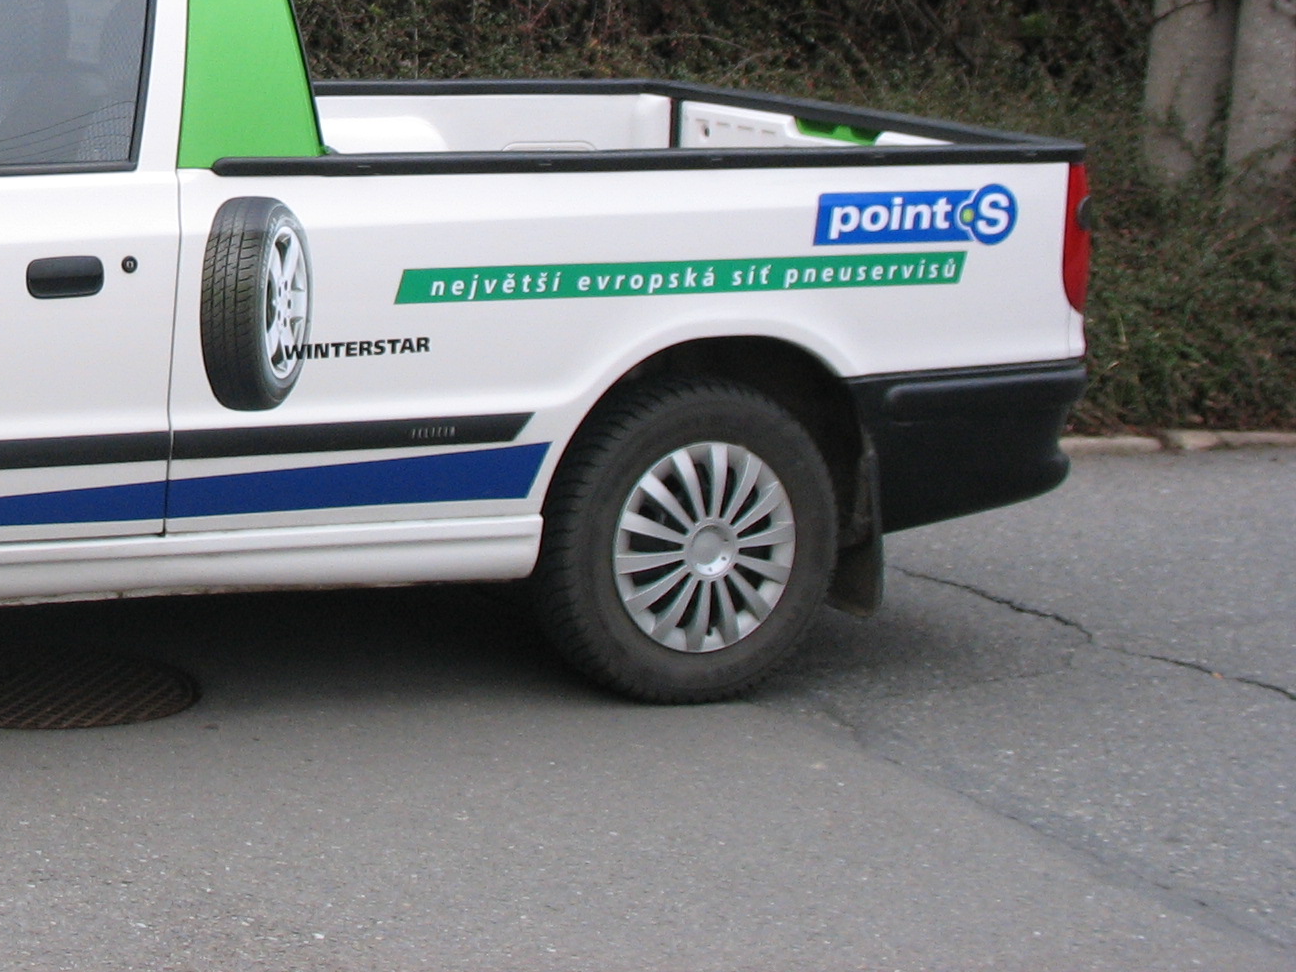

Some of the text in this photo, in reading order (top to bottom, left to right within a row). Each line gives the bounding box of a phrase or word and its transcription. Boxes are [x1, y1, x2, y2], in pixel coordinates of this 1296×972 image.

[828, 192, 1010, 240] point S
[430, 258, 957, 300] největší evropská síť pneuservisů
[283, 336, 431, 361] WINTERSTAR
